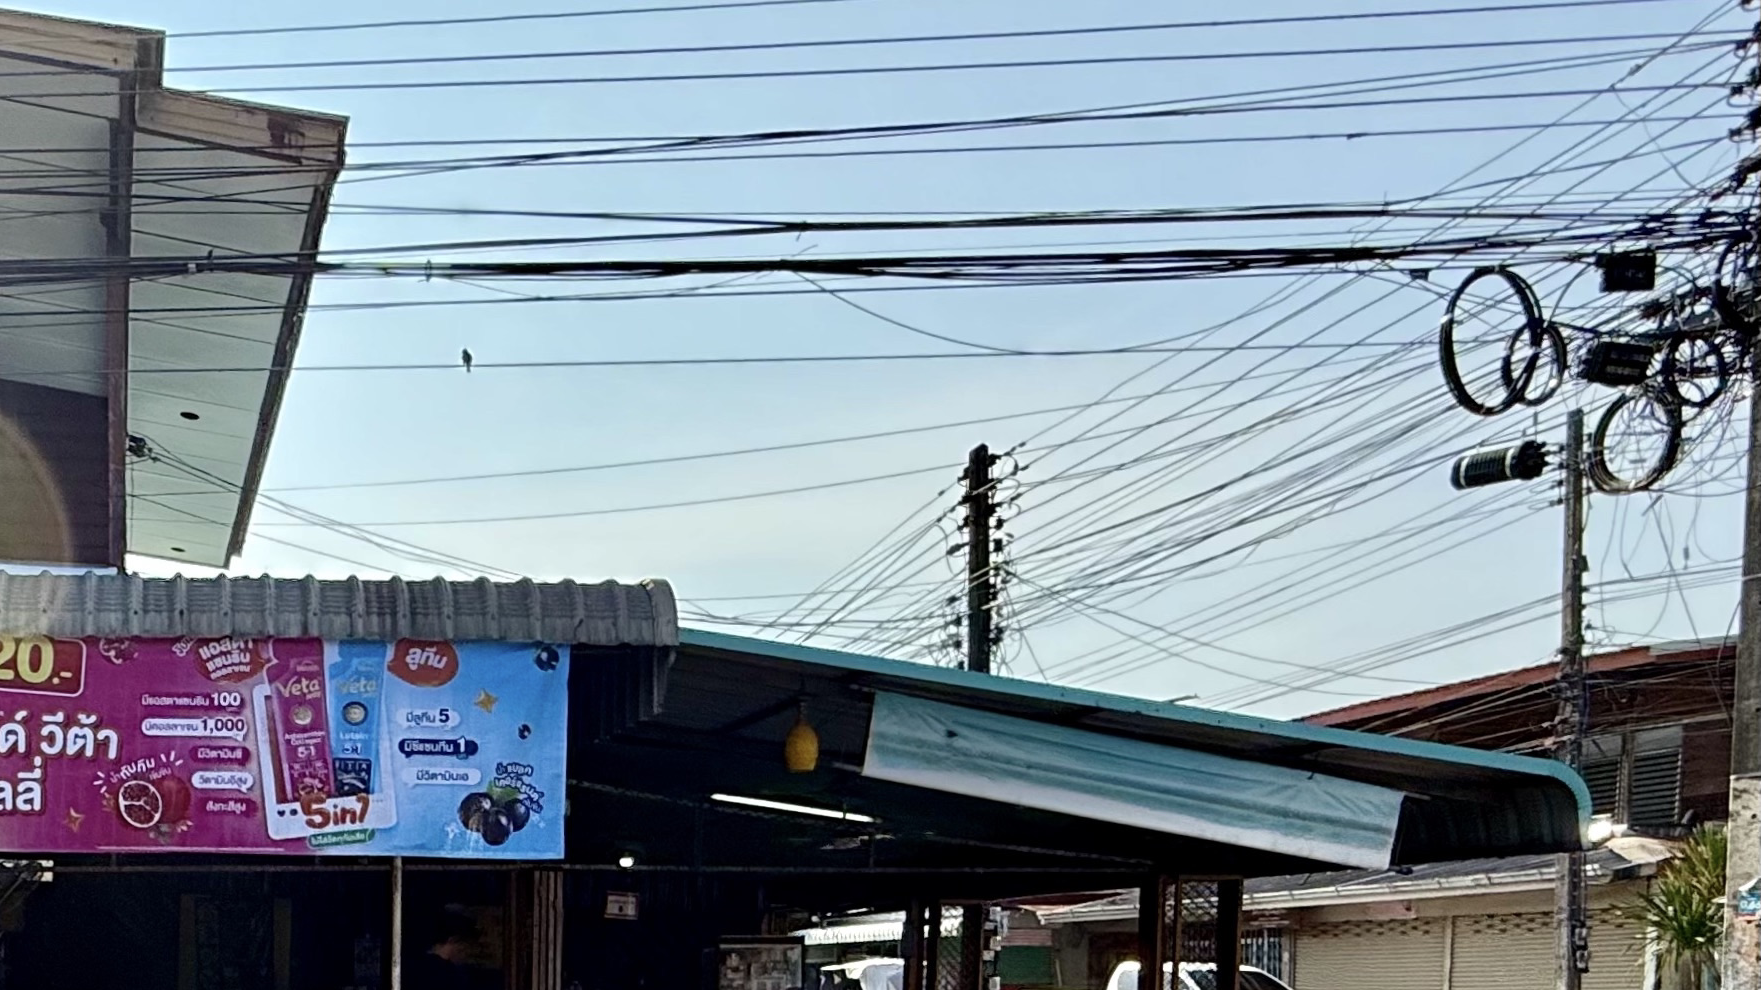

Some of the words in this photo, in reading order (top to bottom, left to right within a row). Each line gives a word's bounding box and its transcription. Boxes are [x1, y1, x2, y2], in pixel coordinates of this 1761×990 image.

[406, 646, 448, 670] ลูทีน
[276, 676, 320, 698] Veta
[211, 692, 241, 706] 100
[439, 708, 450, 724] 5
[201, 719, 245, 734] 1,000
[39, 711, 119, 759] วีต้า
[457, 737, 466, 753] 1
